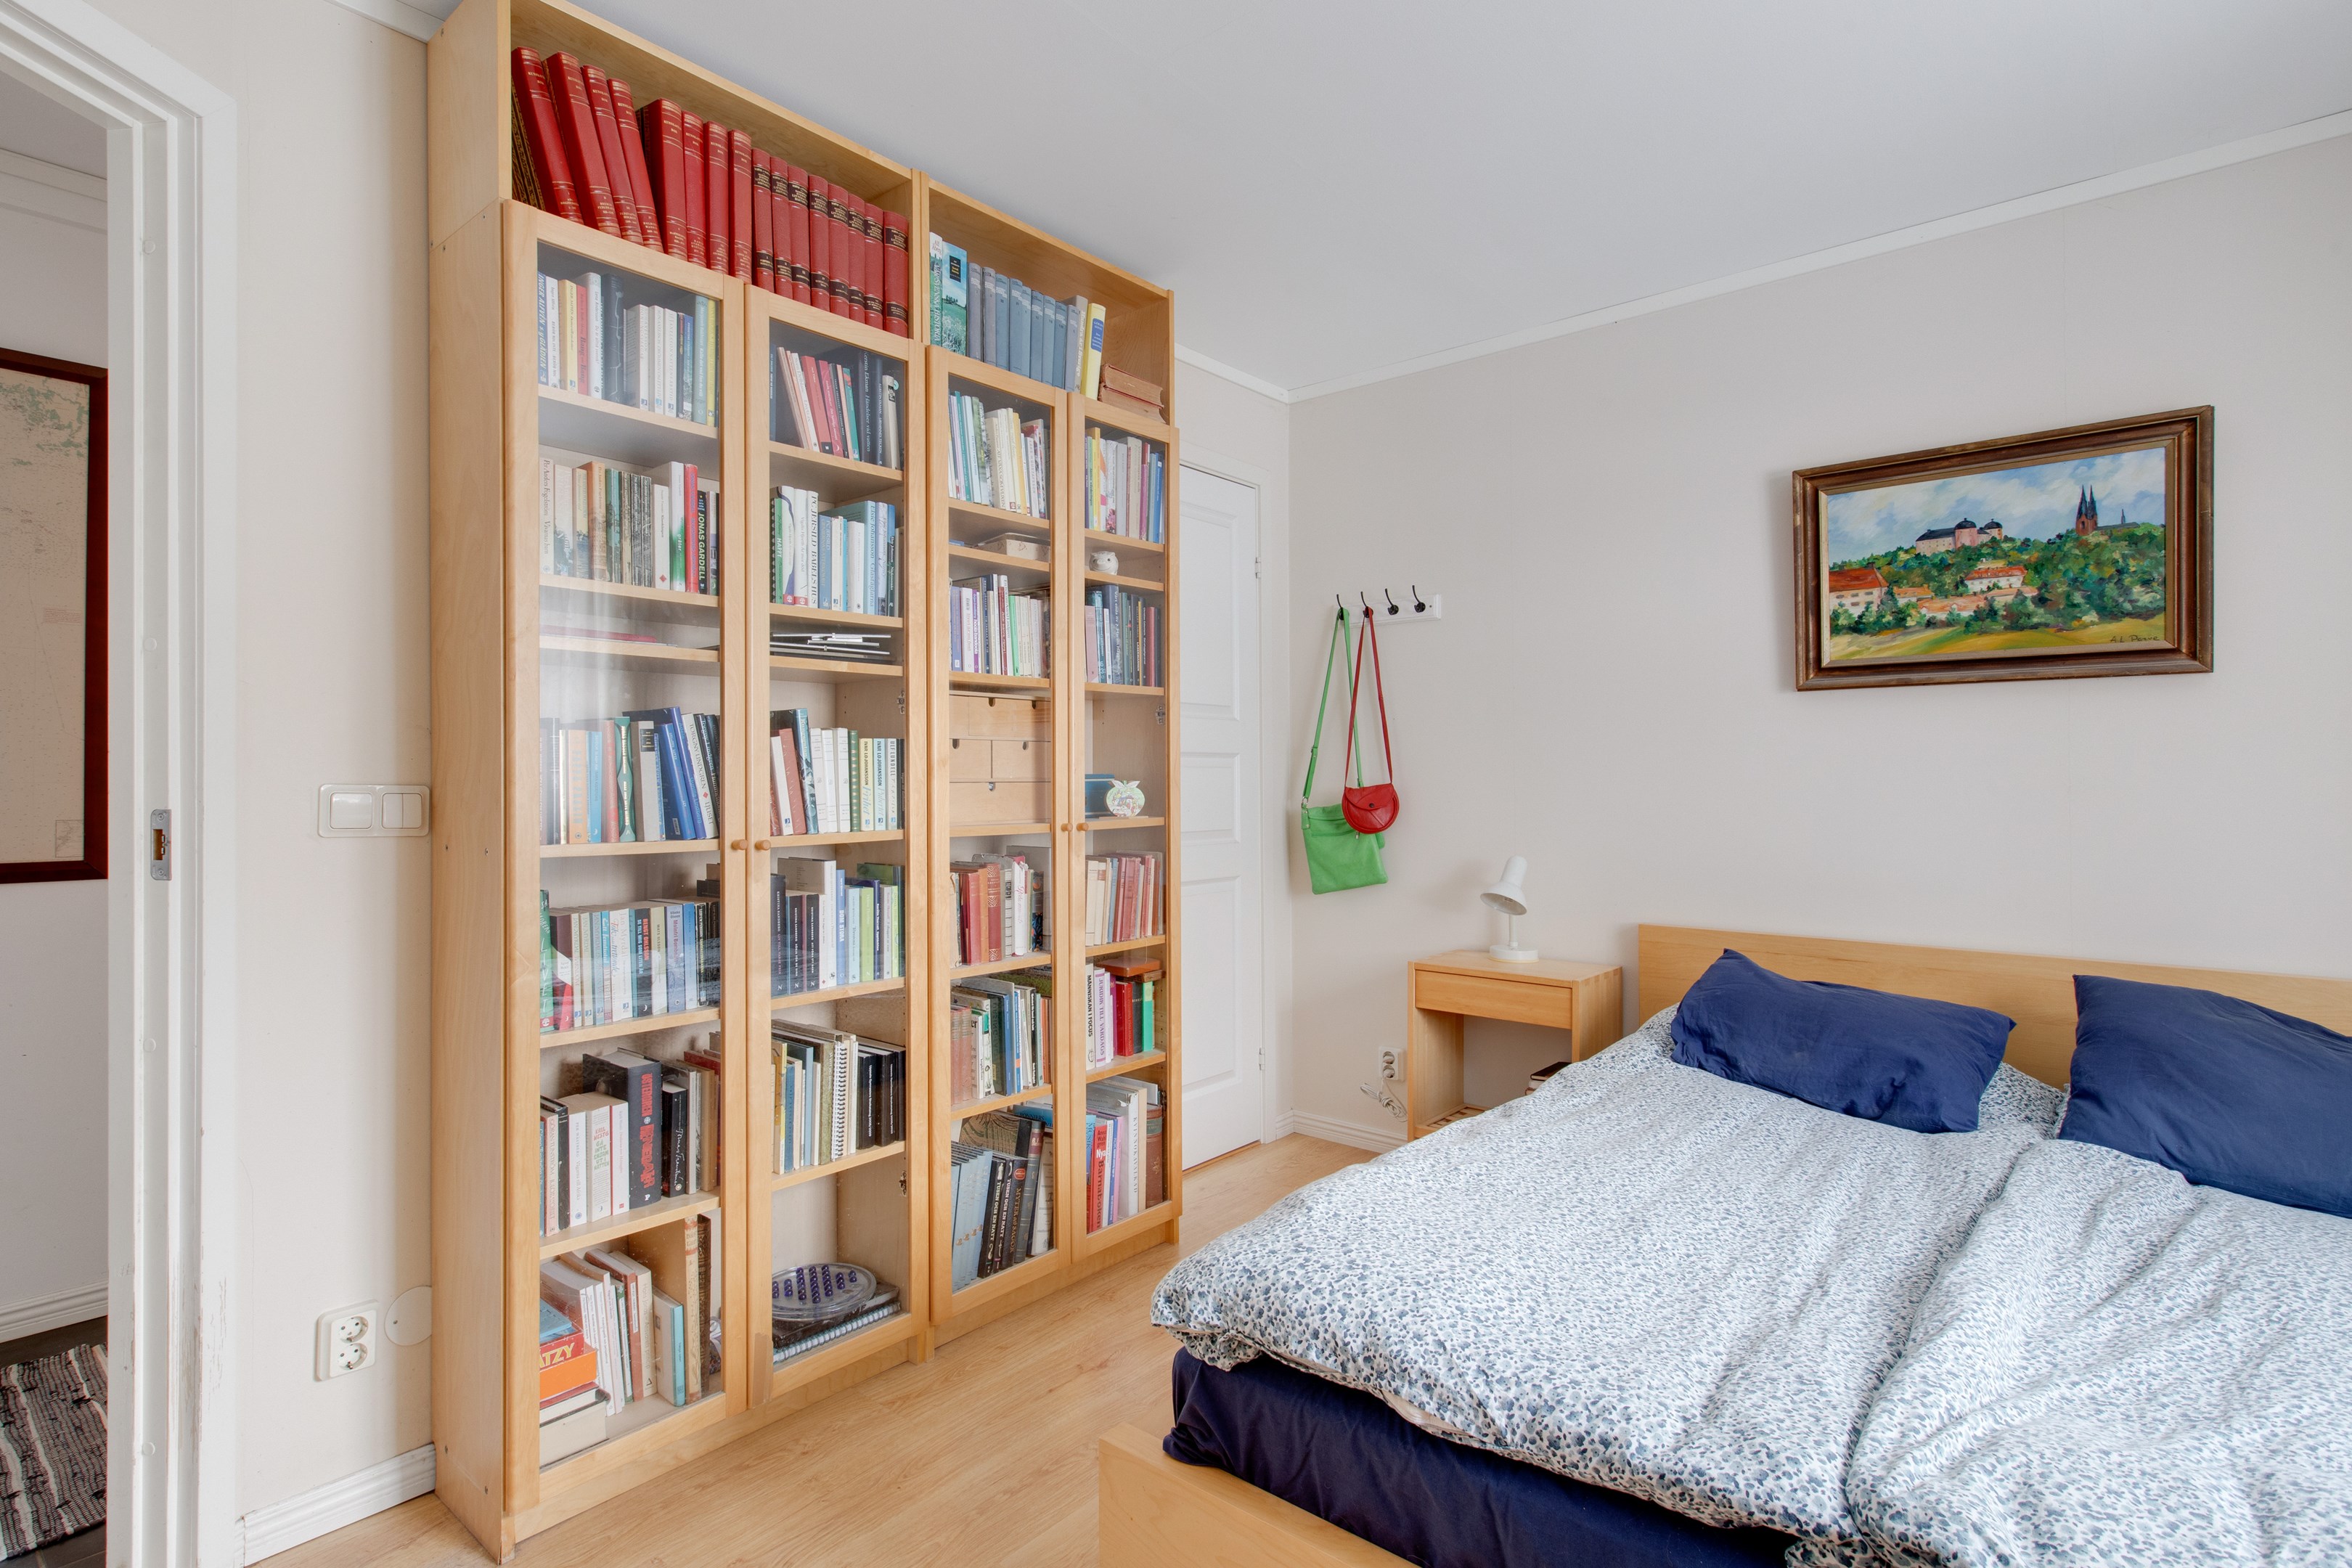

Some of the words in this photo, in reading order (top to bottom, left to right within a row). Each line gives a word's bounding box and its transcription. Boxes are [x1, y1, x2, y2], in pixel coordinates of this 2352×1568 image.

[689, 724, 698, 752] TORGNY
[695, 753, 706, 789] LINDGREN
[704, 801, 714, 825] LJUSET
[862, 786, 871, 815] Frihet
[620, 928, 629, 957] Myrdal
